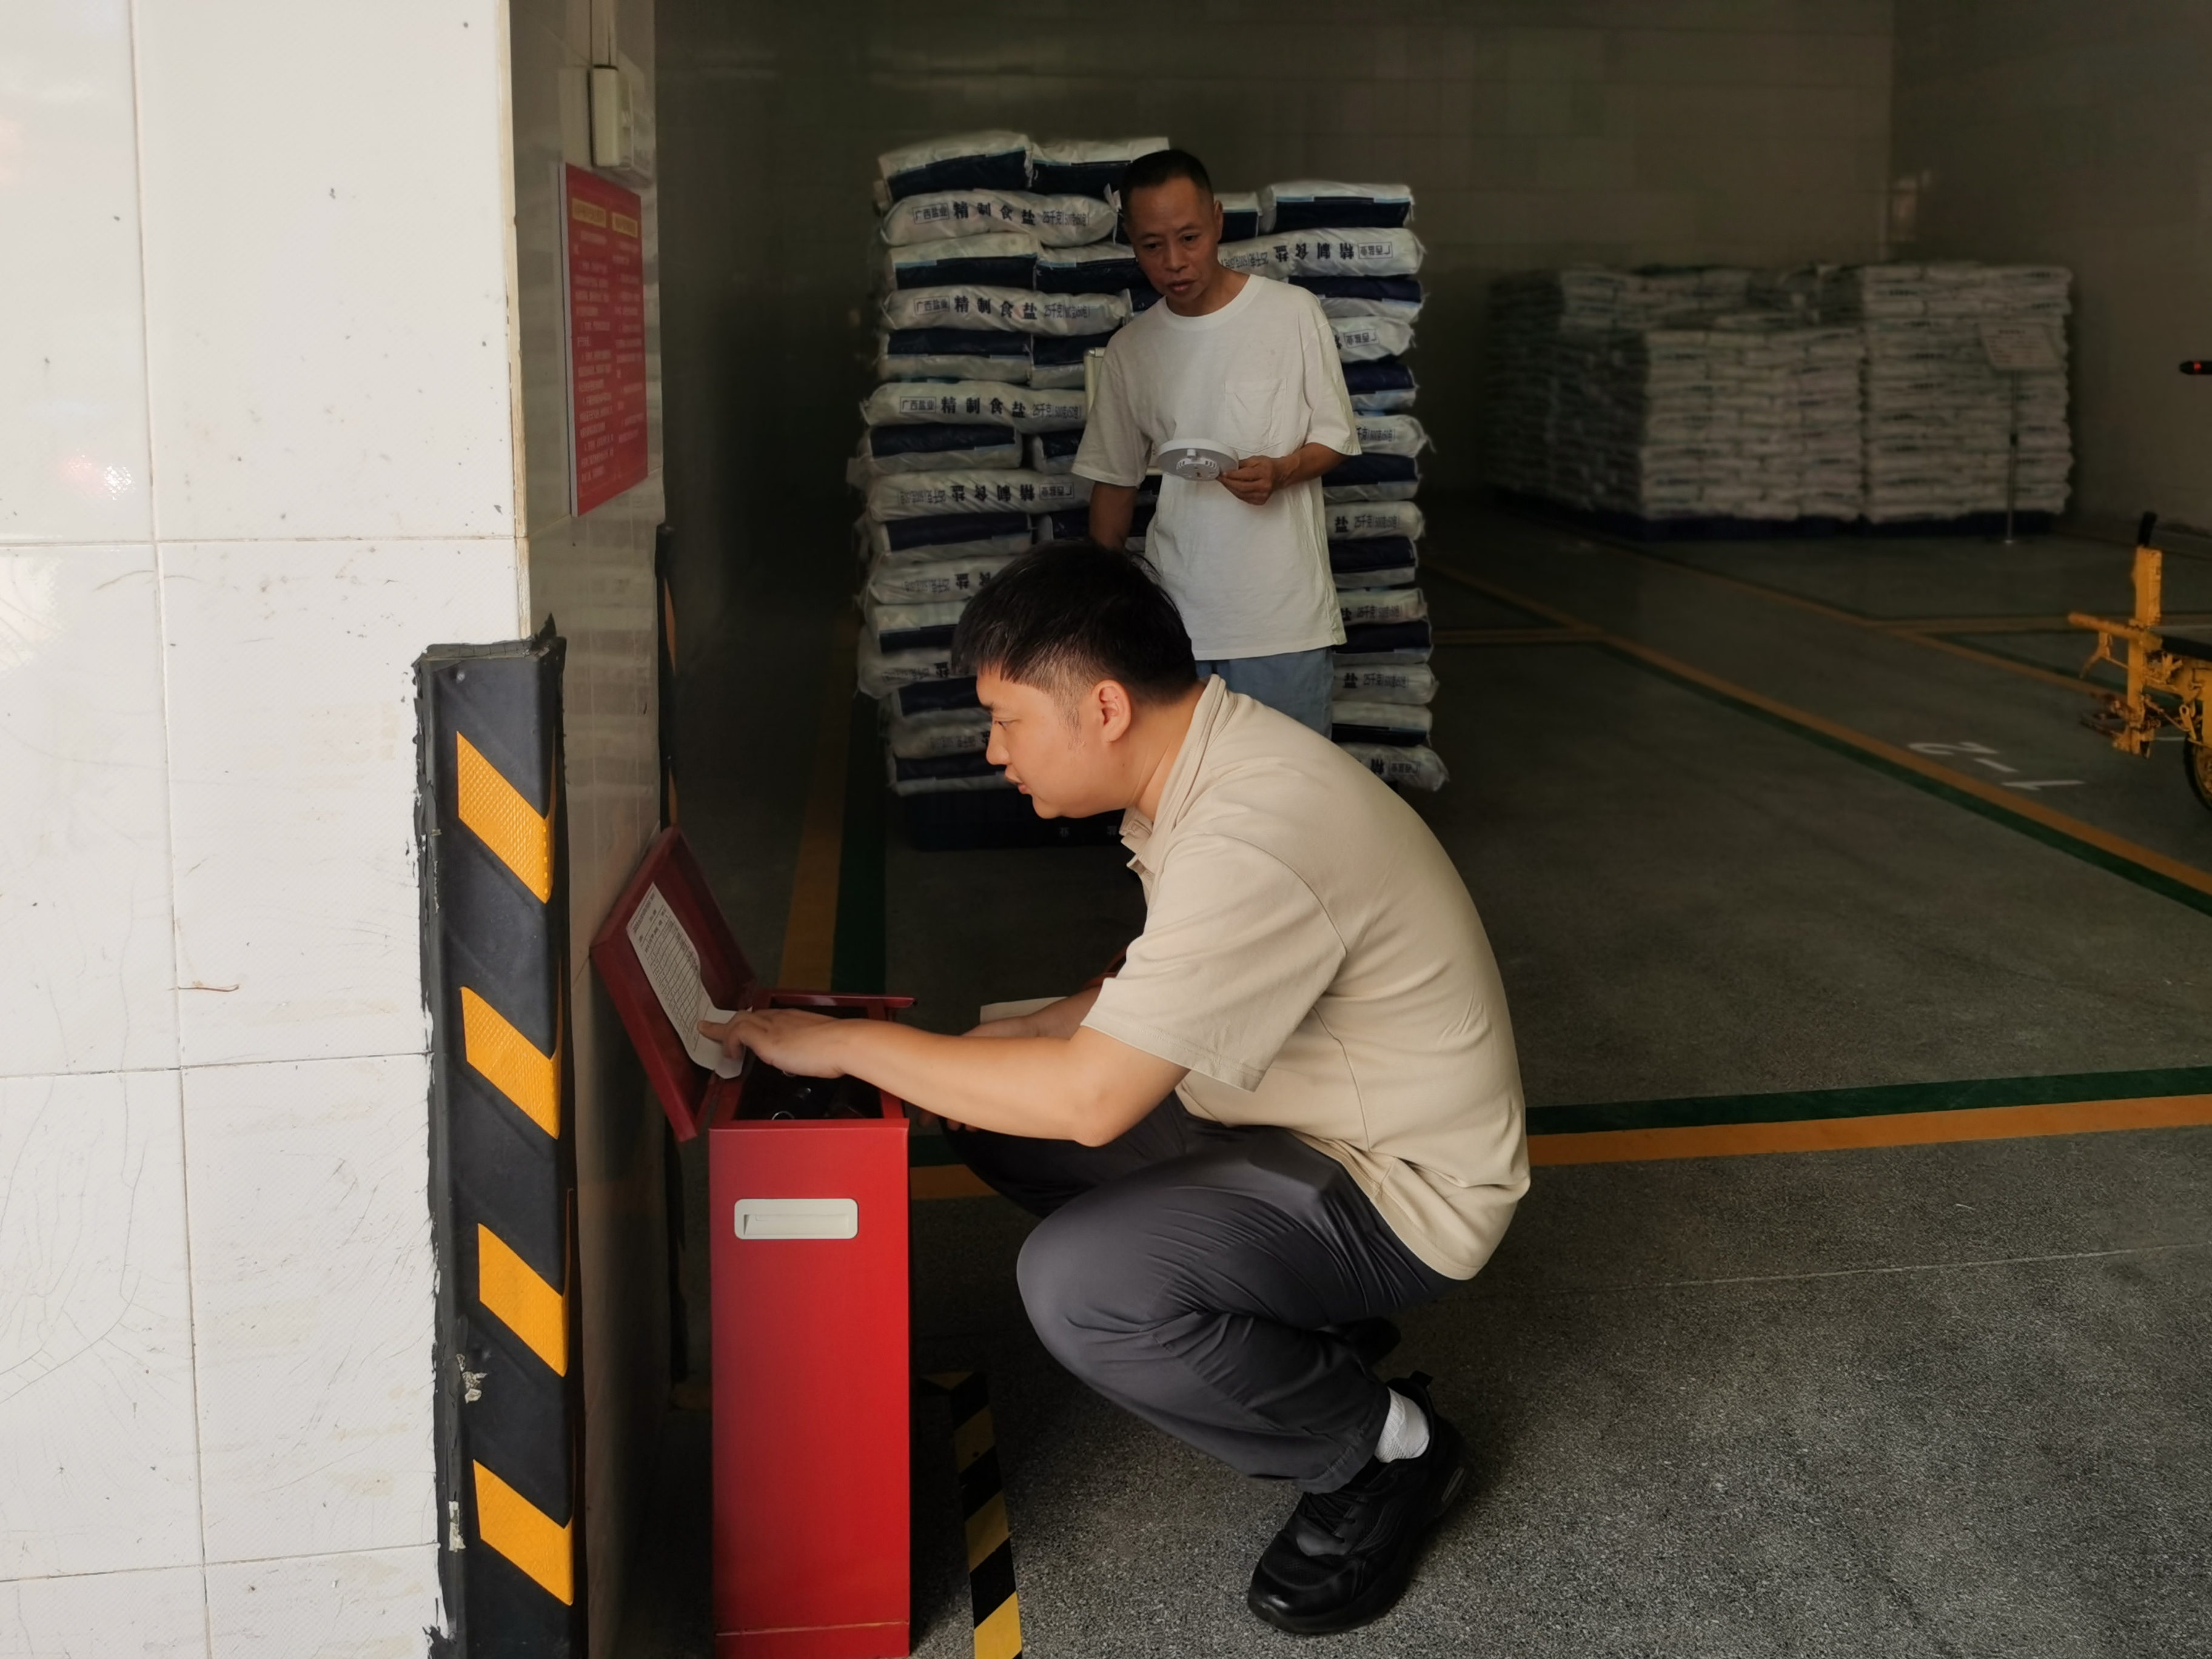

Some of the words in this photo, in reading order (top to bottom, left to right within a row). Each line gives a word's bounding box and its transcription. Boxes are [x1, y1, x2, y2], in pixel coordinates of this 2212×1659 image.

[916, 207, 948, 220] 广西盐业
[953, 201, 1035, 226] 精制食盐
[1273, 243, 1355, 262] 精制食盐
[1360, 244, 1391, 256] 广西盐业
[916, 299, 948, 312] 广西盐业
[954, 295, 1037, 320] 精制食盐
[1346, 332, 1377, 346] 广西盐业
[902, 399, 934, 411] 广西盐业
[941, 396, 1026, 418] 精制食盐
[951, 484, 1034, 502] 精制食盐
[1042, 485, 1073, 497] 广西盐业
